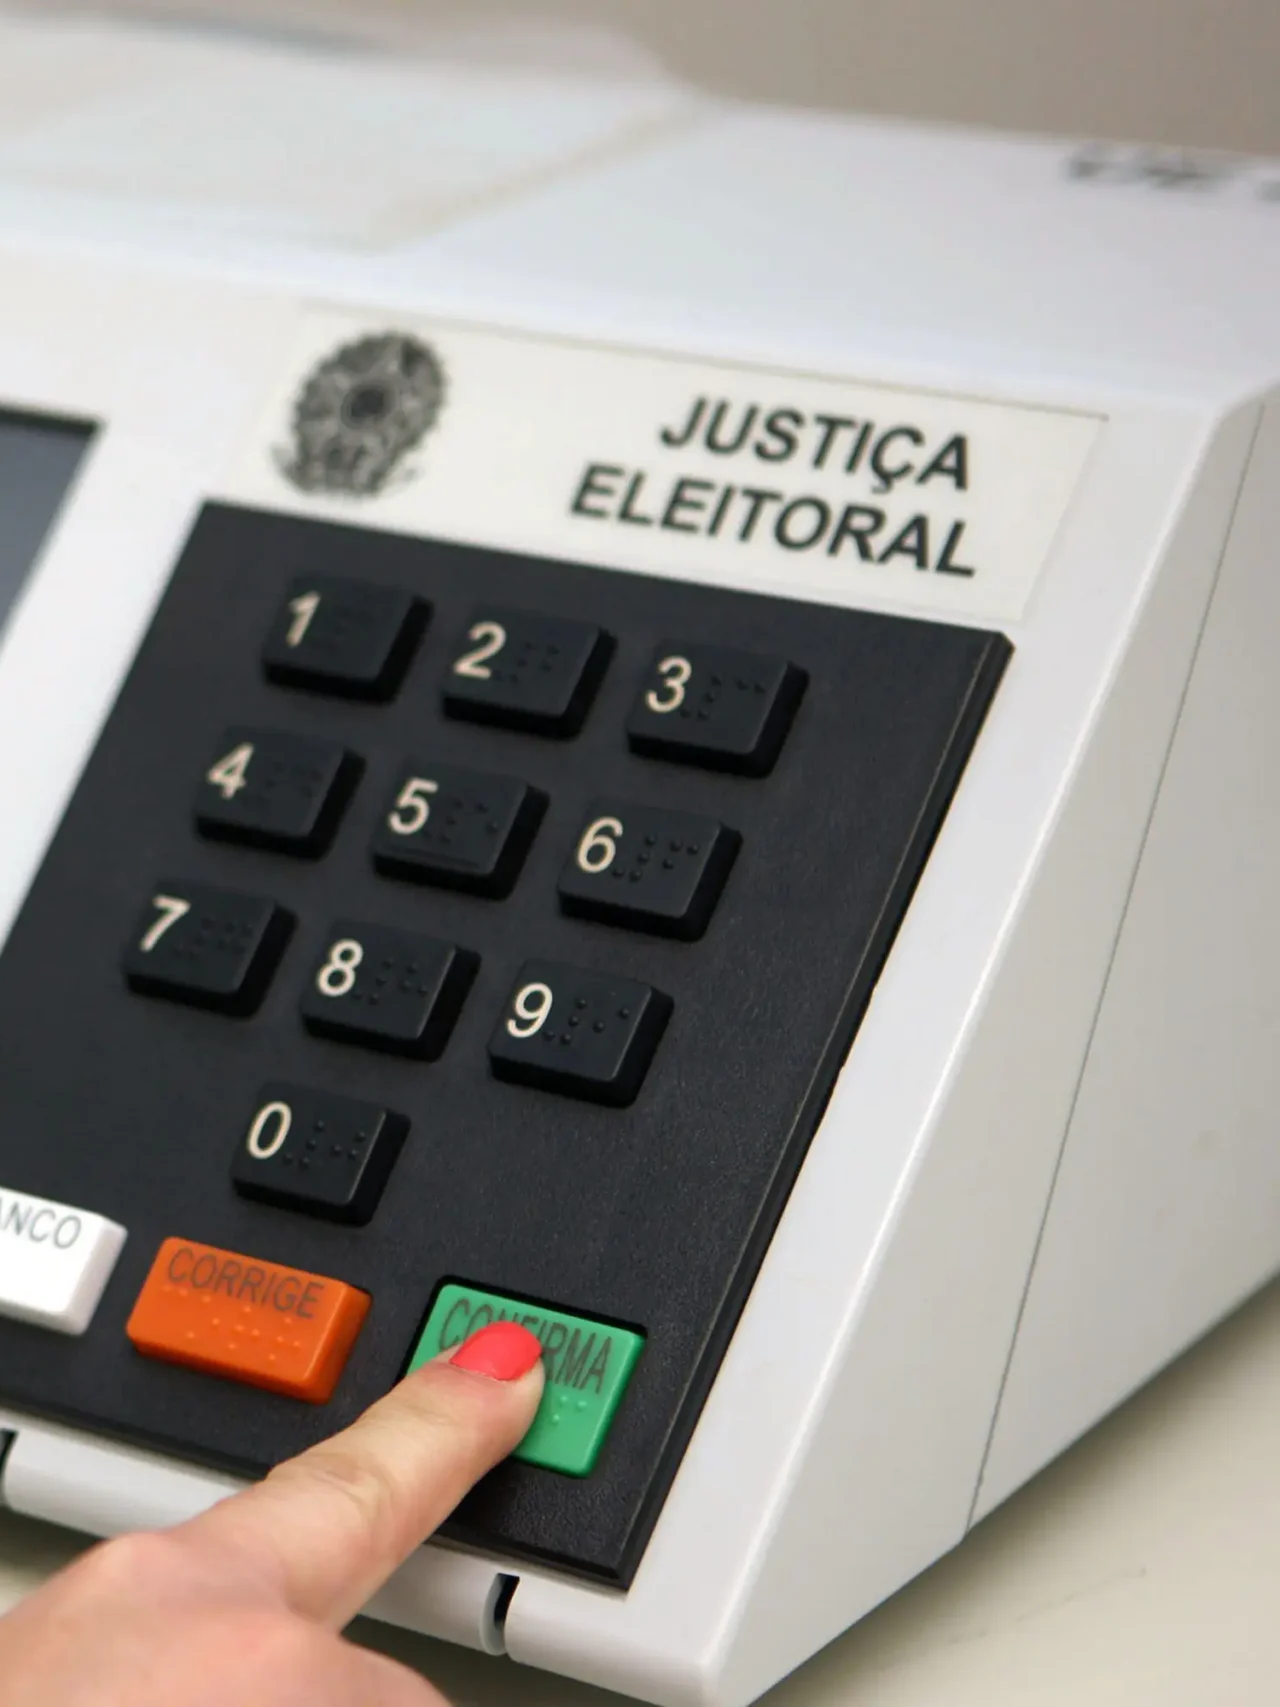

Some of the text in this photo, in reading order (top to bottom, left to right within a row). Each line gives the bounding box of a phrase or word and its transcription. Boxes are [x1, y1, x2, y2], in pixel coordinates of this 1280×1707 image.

[660, 395, 971, 494] JUSTIÇA
[569, 464, 977, 578] ELEITORAL
[288, 592, 319, 646] 1
[454, 622, 507, 678] 2
[646, 657, 693, 712] 3
[208, 744, 254, 799] 4
[388, 779, 438, 834] 5
[577, 817, 624, 874] 6
[138, 897, 191, 951] 7
[316, 940, 364, 996] 8
[506, 982, 554, 1038] 9
[246, 1102, 292, 1159] 0
[166, 1247, 326, 1318] CORRIGE
